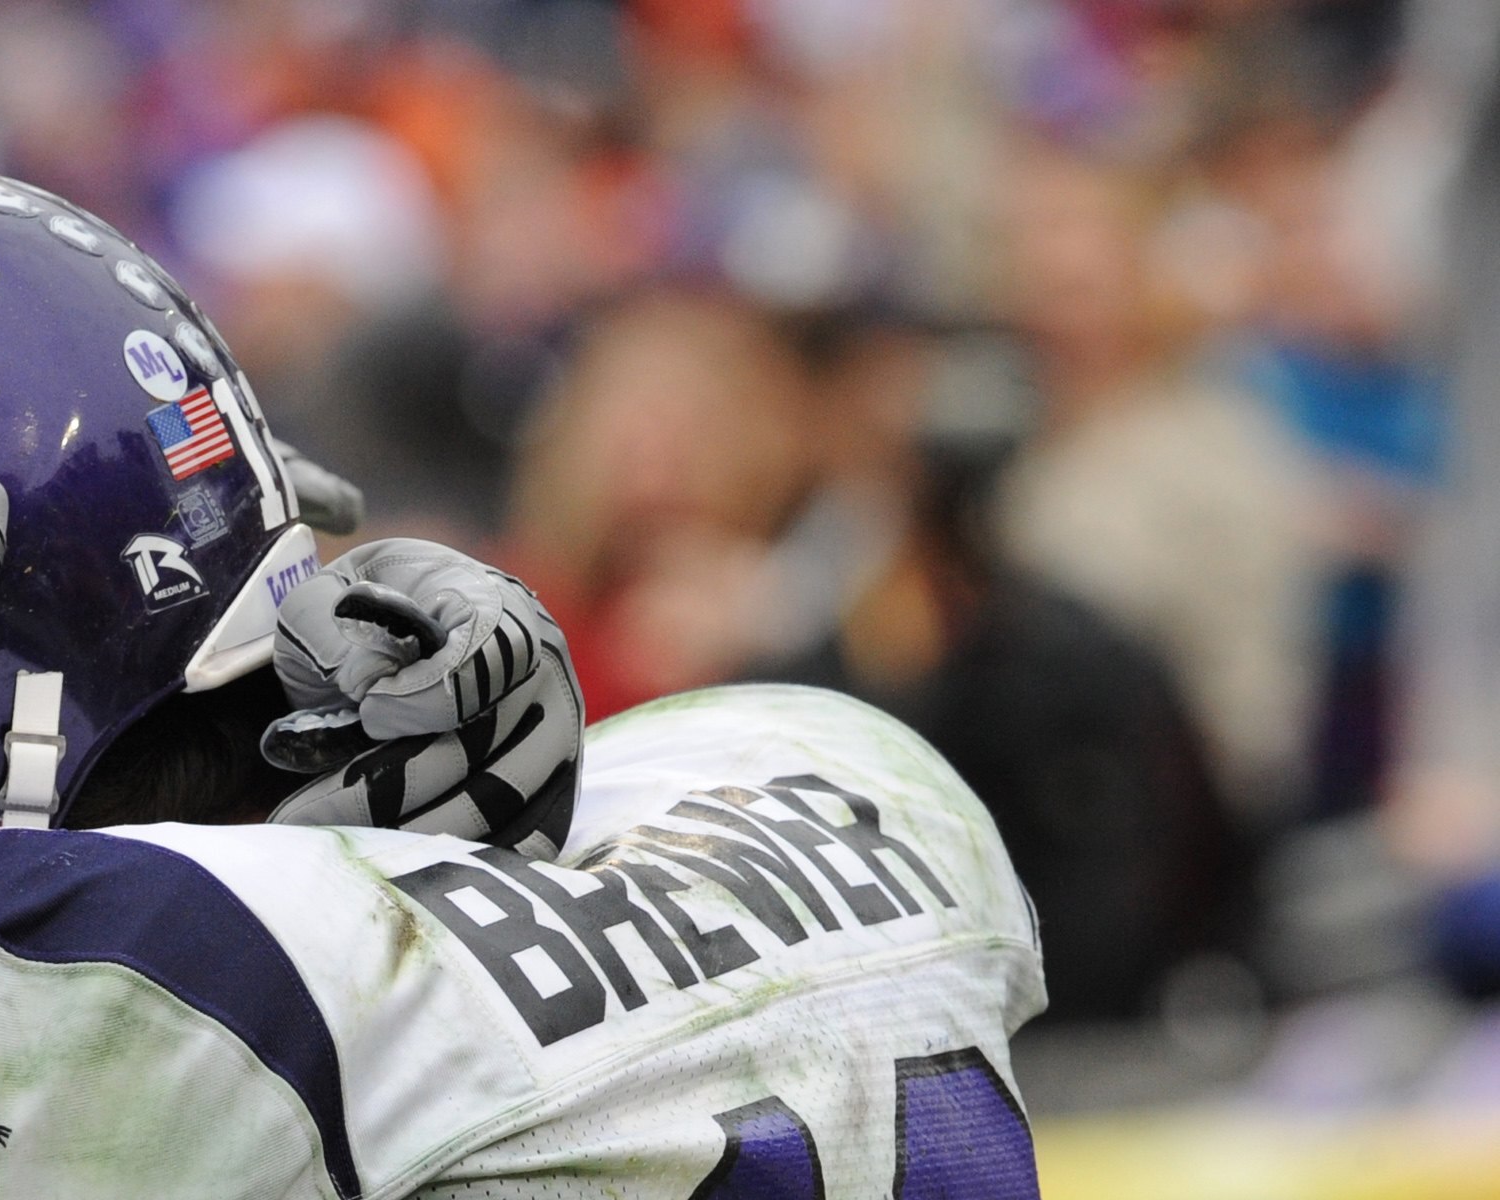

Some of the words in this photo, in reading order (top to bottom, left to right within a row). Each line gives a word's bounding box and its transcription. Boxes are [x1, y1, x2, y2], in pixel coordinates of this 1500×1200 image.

[126, 341, 184, 384] ML
[154, 581, 190, 601] MEDIUM
[389, 773, 958, 1047] BREWER
